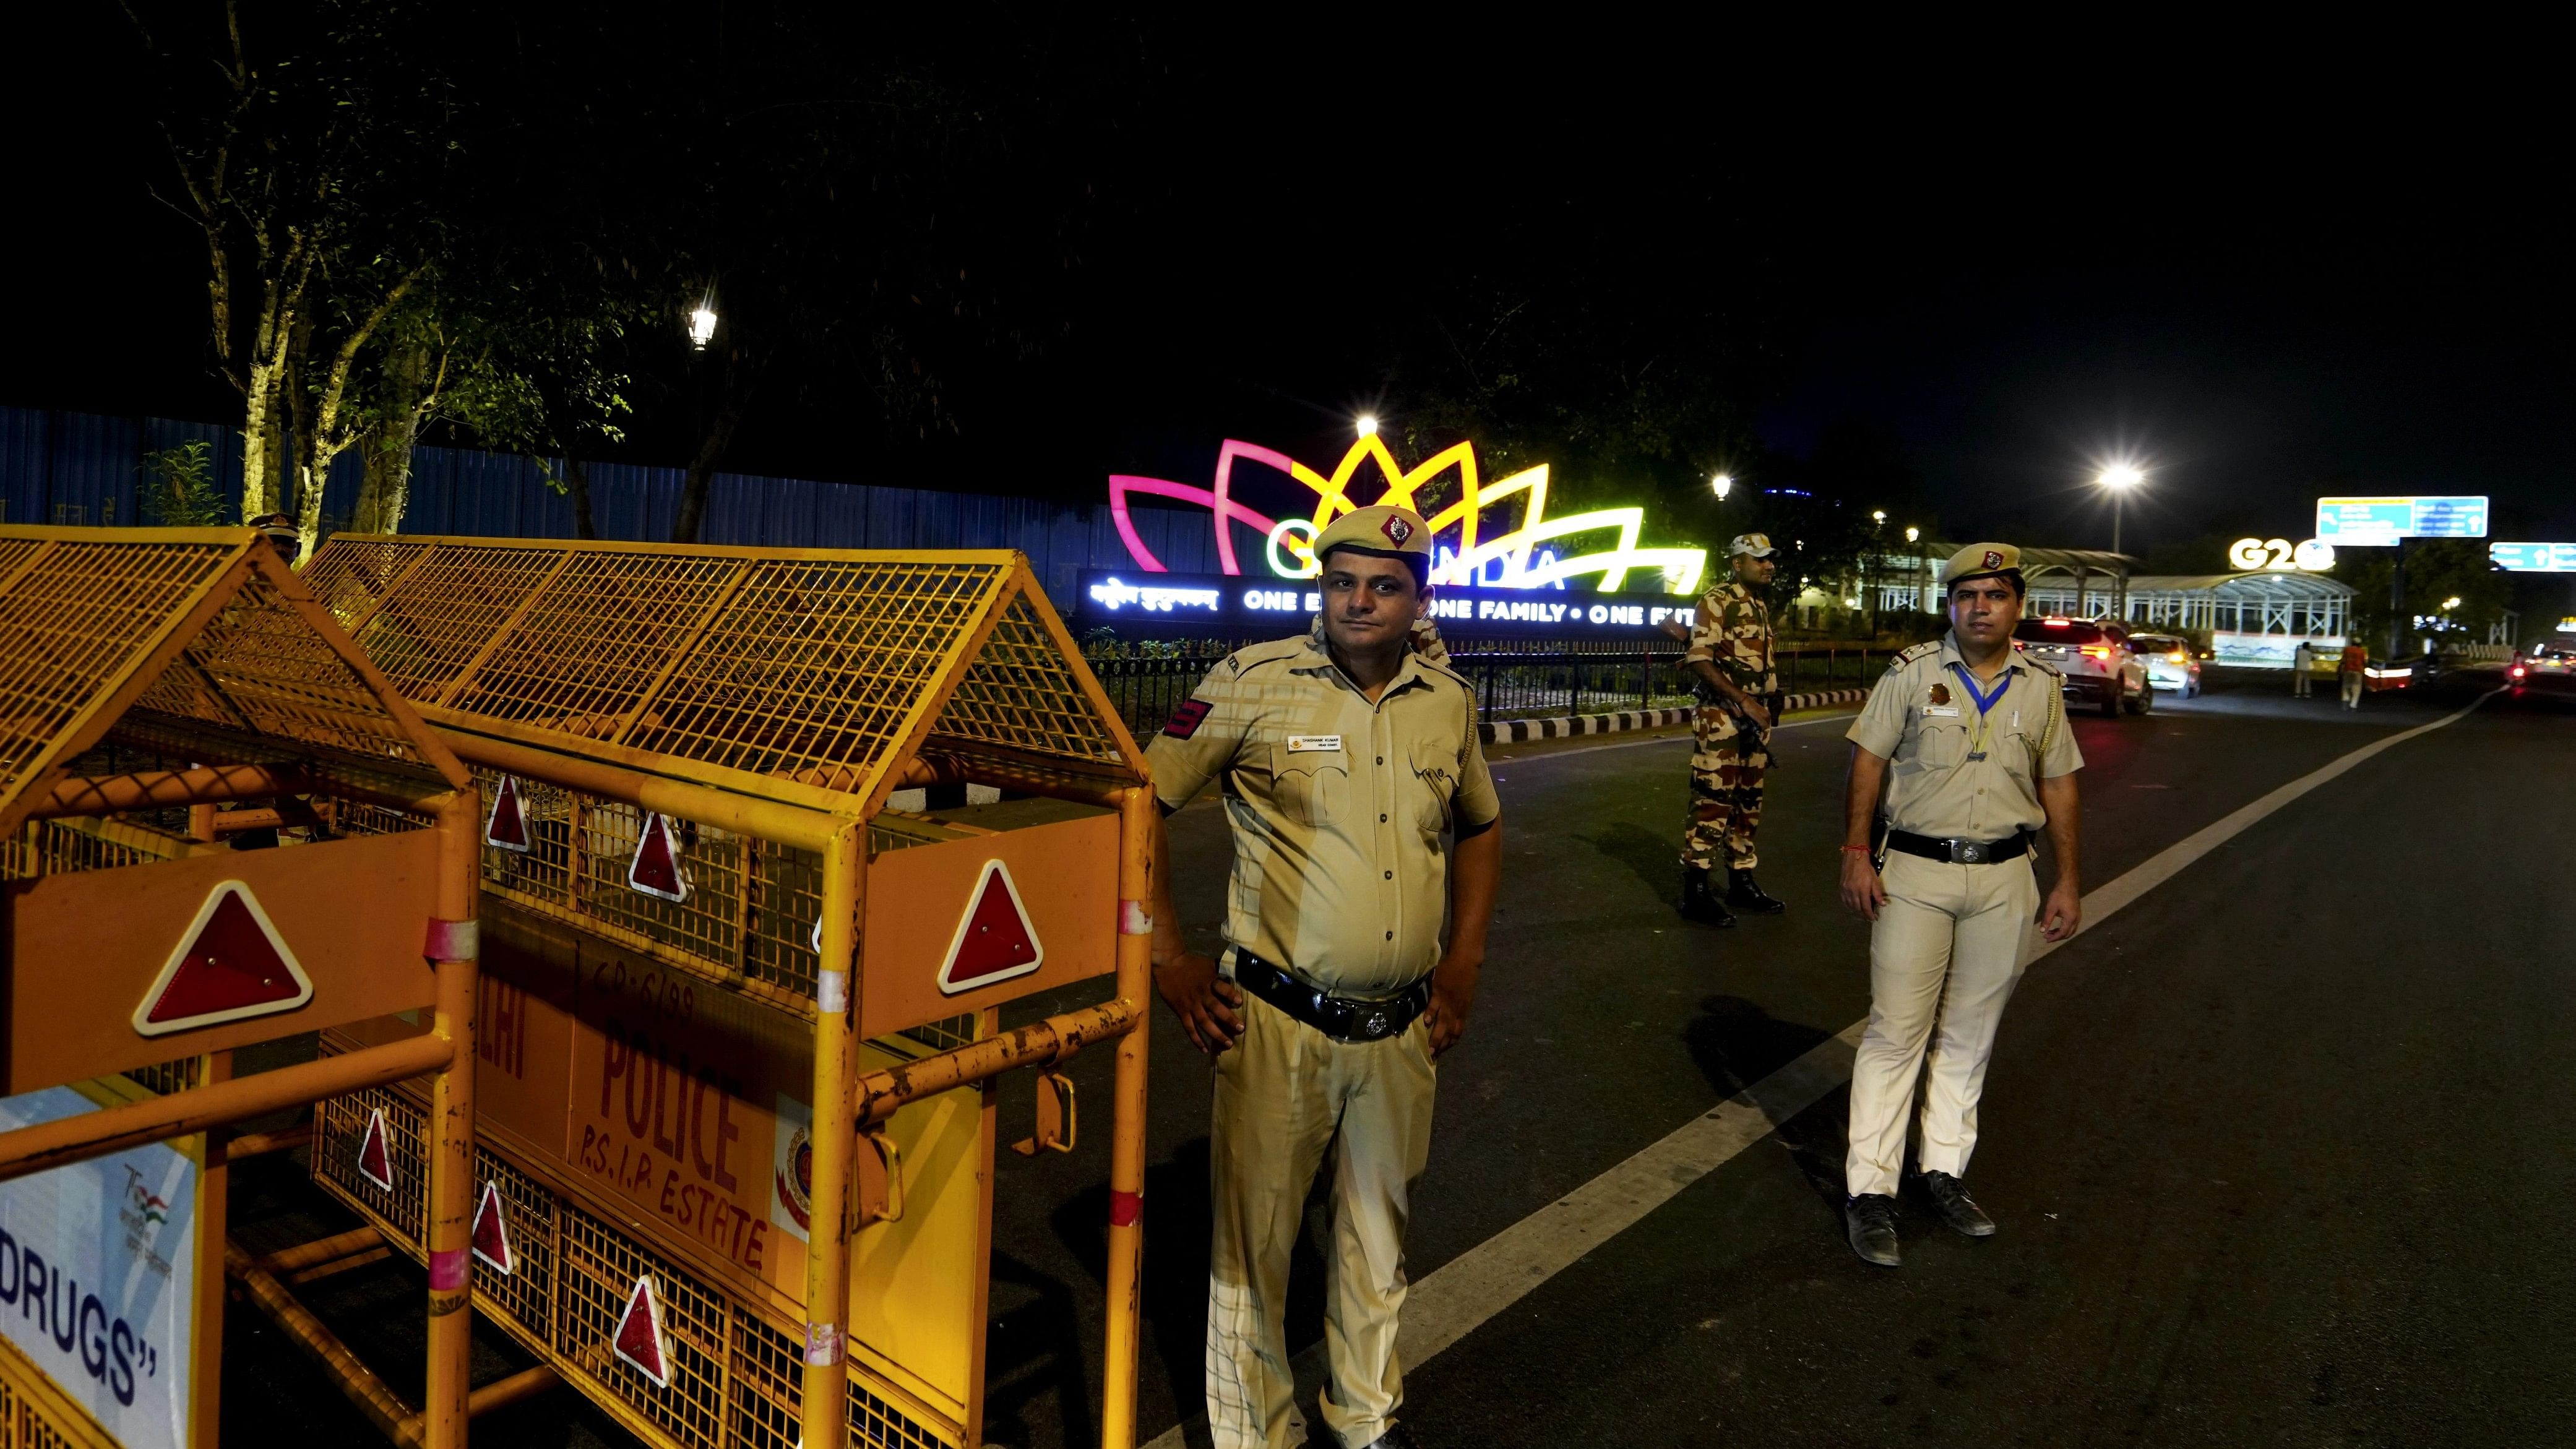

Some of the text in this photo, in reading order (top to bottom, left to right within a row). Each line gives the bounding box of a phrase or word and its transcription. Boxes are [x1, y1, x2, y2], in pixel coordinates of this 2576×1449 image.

[1244, 590, 1297, 611] ONE
[1480, 601, 1567, 622] FAMILY
[1589, 604, 1643, 626] ONE
[1650, 608, 1695, 627] FUT
[601, 1017, 742, 1194] POLICE
[660, 1169, 768, 1270] ESTATE
